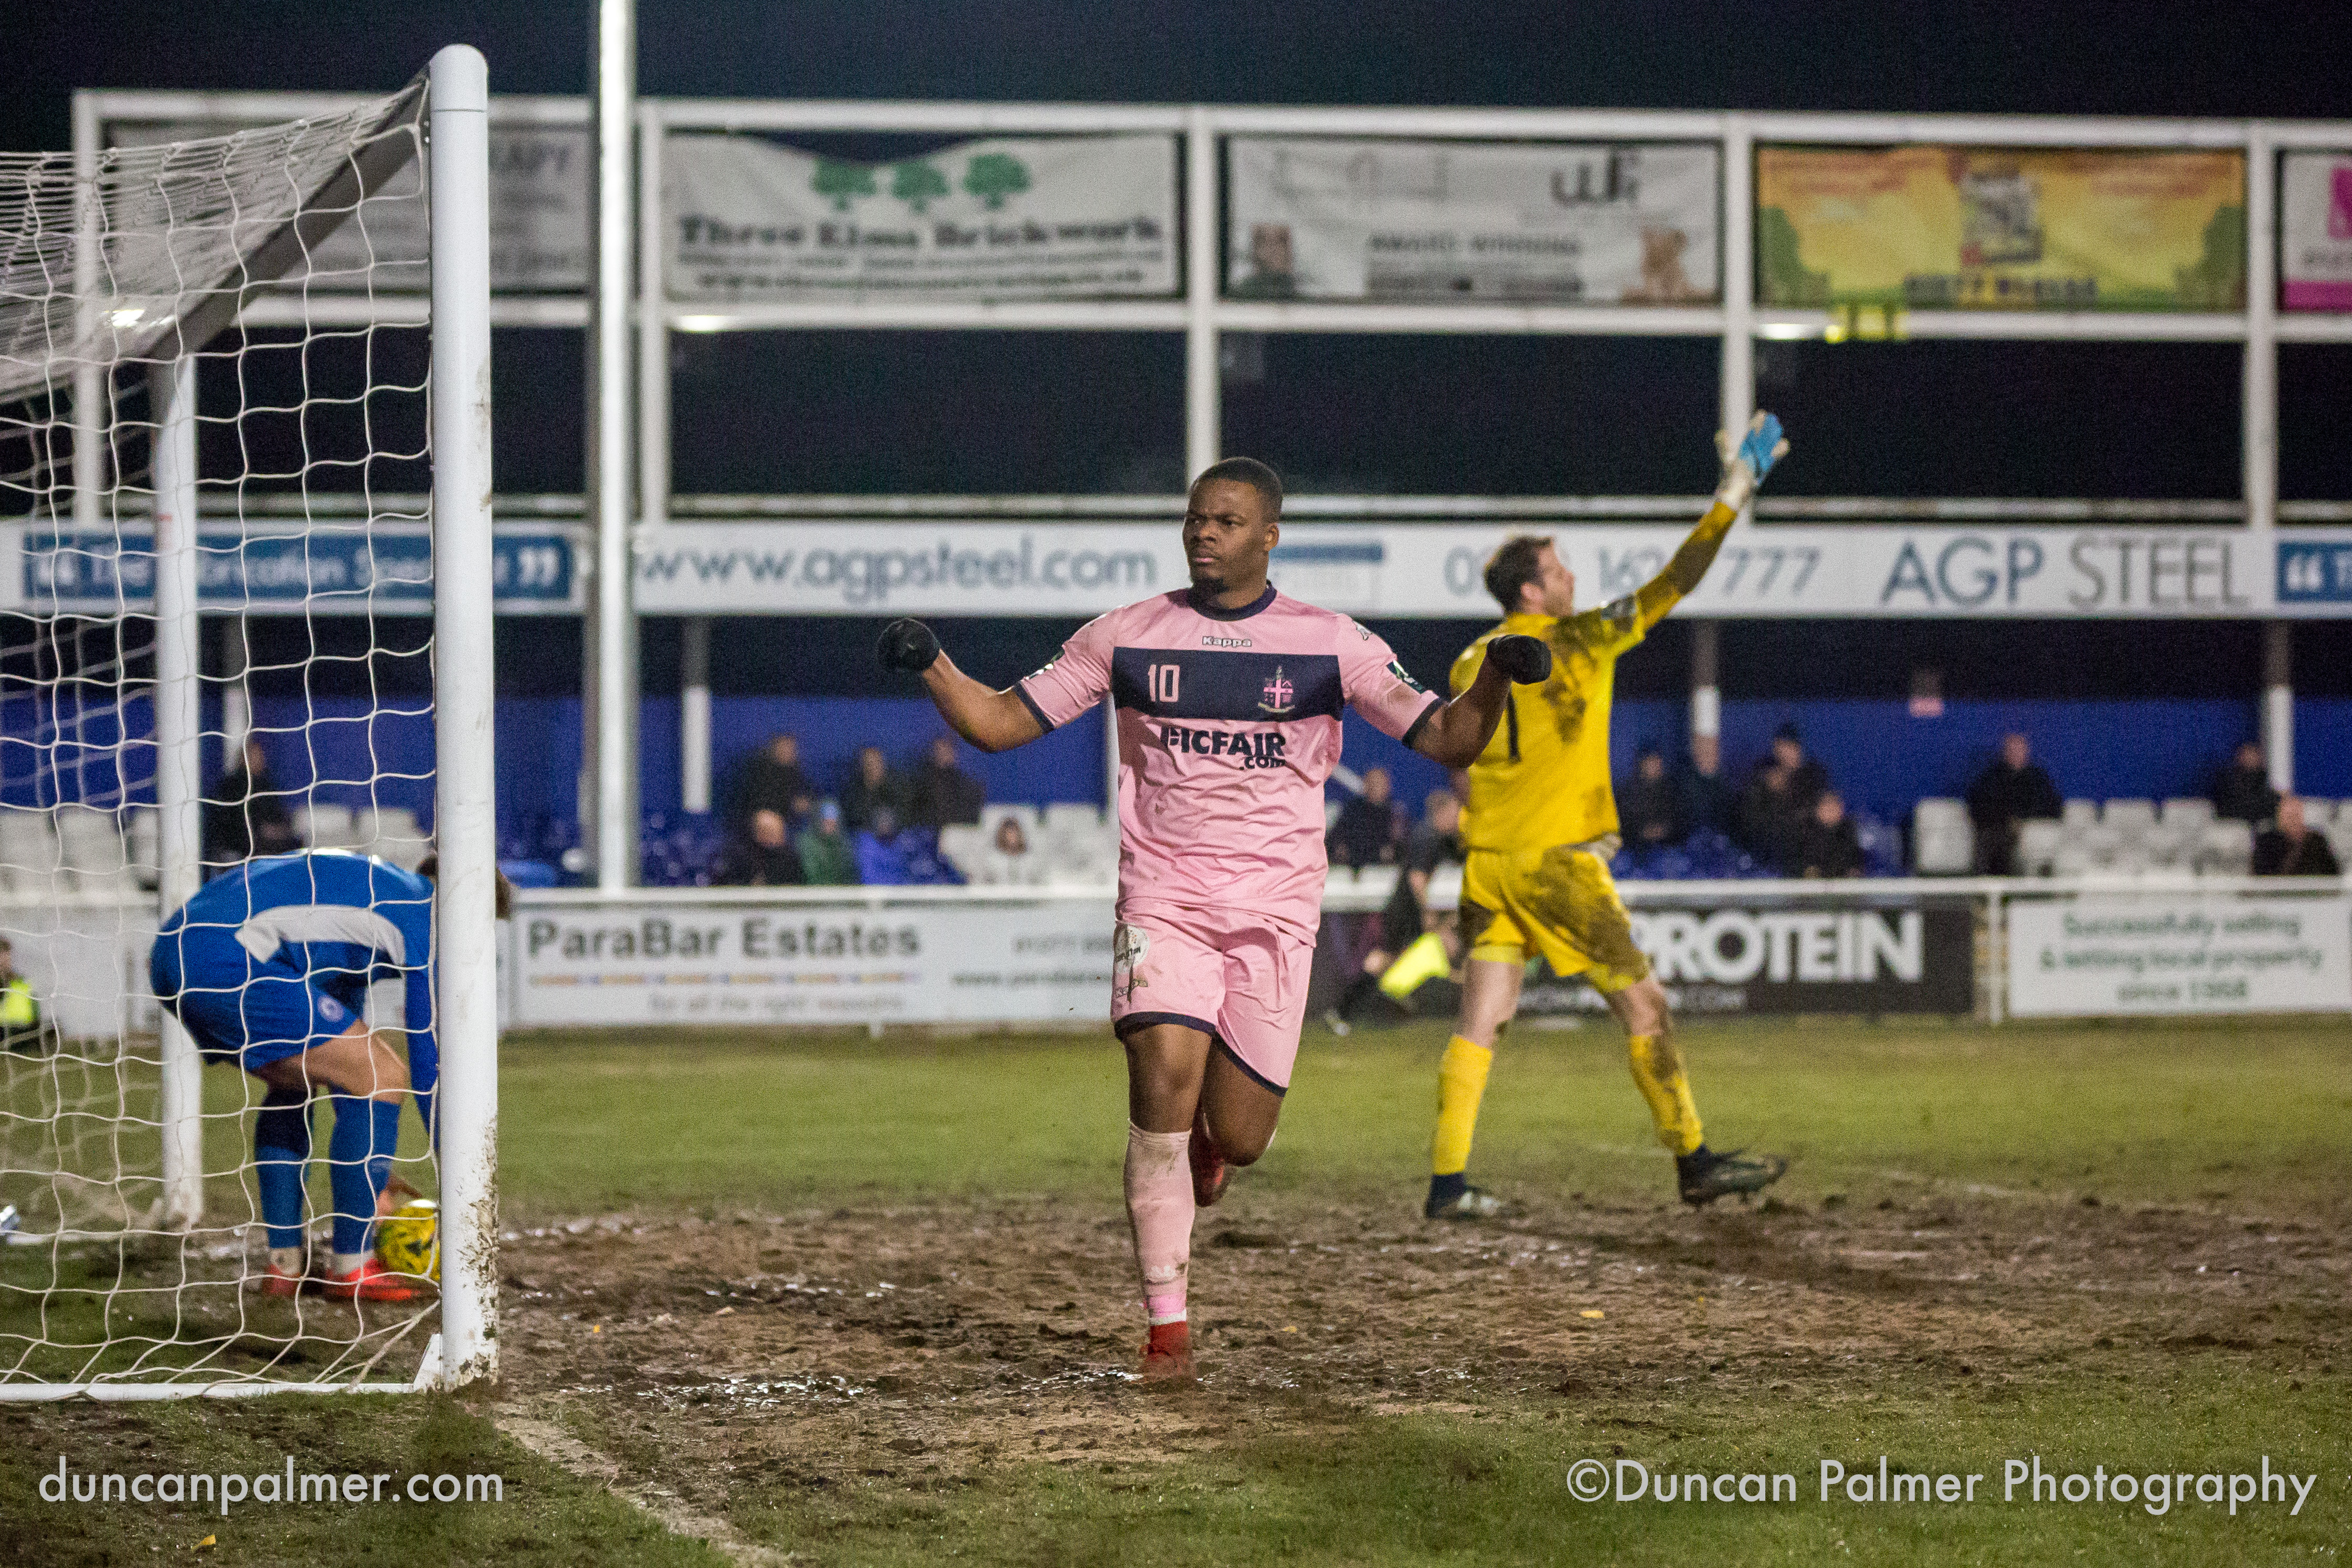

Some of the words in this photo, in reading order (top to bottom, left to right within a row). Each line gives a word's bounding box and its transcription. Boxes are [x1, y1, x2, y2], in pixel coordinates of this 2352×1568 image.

[1878, 535, 2046, 608] AGP
[2068, 534, 2251, 608] STEEL
[1202, 635, 1252, 648] Kappa
[1147, 664, 1180, 702] 10
[527, 917, 726, 960] ParaBar
[740, 916, 920, 959] Estates
